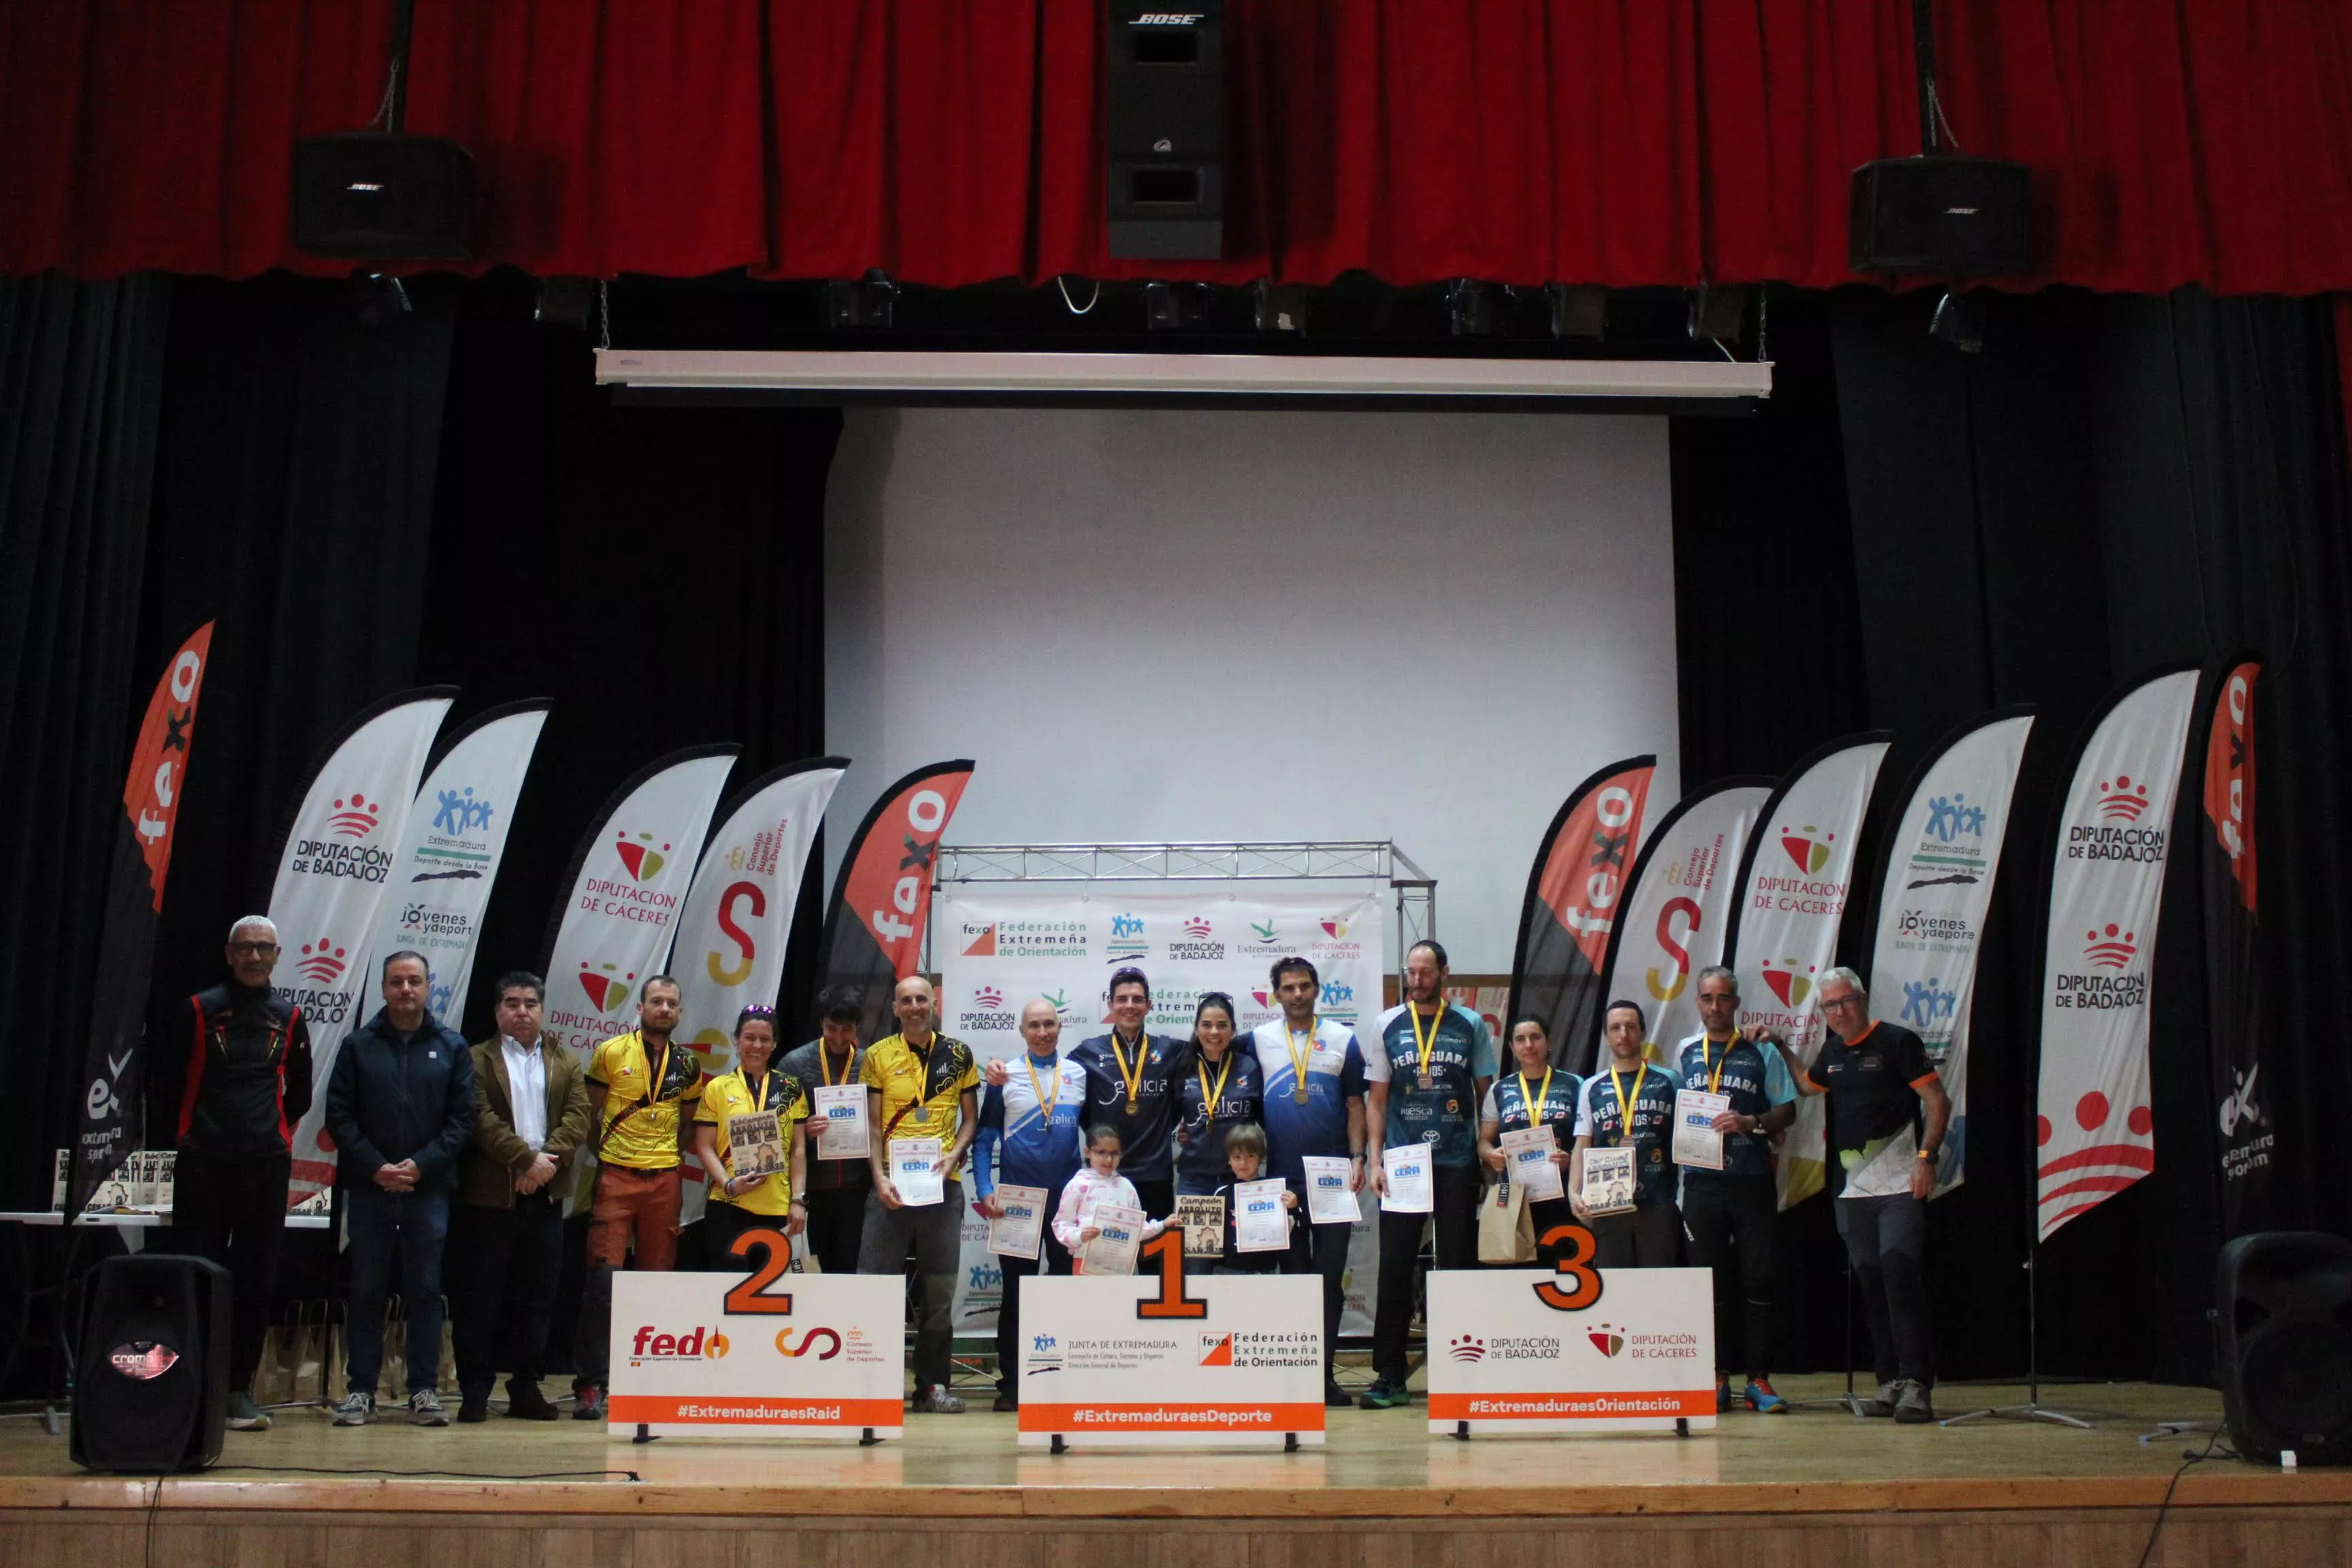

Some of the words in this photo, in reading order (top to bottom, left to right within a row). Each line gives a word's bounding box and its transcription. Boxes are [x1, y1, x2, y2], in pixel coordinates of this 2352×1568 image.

[1128, 14, 1204, 24] BOSE
[138, 650, 201, 845] fexo
[428, 836, 487, 851] Extremadura
[770, 818, 787, 859] Deportes
[2070, 826, 2164, 847] DIPUTACIÓN
[297, 840, 393, 868] DIPUTACIÓN
[747, 832, 763, 872] Consejo
[756, 832, 774, 874] Superior
[1921, 843, 1980, 856] Extremadura
[2069, 846, 2084, 859] DE
[2087, 845, 2163, 864] BADAJOZ
[414, 855, 441, 866] Deporte
[443, 858, 463, 868] desde
[474, 862, 488, 870] Base
[767, 859, 774, 876] de
[872, 789, 946, 943] fexo
[1567, 786, 1633, 938] fexo
[1684, 847, 1700, 886] Consejo
[1908, 863, 1935, 873] Deporte
[1937, 865, 1957, 874] desde
[292, 859, 308, 873] DE
[312, 858, 389, 883] BADAJOZ
[1758, 876, 1846, 897] DIPUTACIÓN
[581, 896, 599, 911] DE
[604, 898, 670, 927] CÁCERES
[1754, 895, 1774, 909] DE
[1779, 895, 1843, 915] CÁCERES
[423, 924, 472, 935] ydeport
[964, 923, 990, 934] fexo
[1000, 921, 1086, 932] Federación
[1000, 933, 1086, 944] Extremeña
[1170, 941, 1224, 951] DIPUTACIÓN
[999, 947, 1014, 957] de
[1017, 946, 1086, 957] Orientación
[1181, 951, 1224, 960] BADAJOZ
[1237, 945, 1296, 953] Extremadura
[2055, 994, 2072, 1008] DE
[2077, 989, 2144, 1009] BADAOZ
[961, 1011, 1015, 1022] DIPUTACIÓN
[1156, 1014, 1196, 1024] Orient
[972, 1022, 1015, 1030] BADAJOZ
[1098, 1078, 1168, 1105] glicia
[828, 1108, 856, 1119] CERA
[902, 1161, 930, 1172] CERA
[1180, 1196, 1222, 1206] Campeón
[1248, 1202, 1275, 1212] CERA
[1178, 1206, 1222, 1214] ABSOLUTO
[724, 1226, 793, 1316] 2
[1137, 1226, 1208, 1319] 1
[1533, 1223, 1603, 1312] 3
[1068, 1341, 1097, 1350] JUNTA
[1100, 1341, 1110, 1349] DE
[1113, 1341, 1177, 1349] EXTREMADURA
[1203, 1335, 1229, 1347] fexo
[1235, 1331, 1318, 1343] Federación
[1491, 1335, 1560, 1348] DIPUTACIÓN
[1632, 1332, 1697, 1345] DIPUTACIÓN
[1235, 1343, 1318, 1355] Extremeña
[1491, 1351, 1502, 1359] DE
[1505, 1349, 1560, 1359] BADAJOZ
[1632, 1349, 1645, 1358] DE
[1649, 1345, 1697, 1358] CÁCERES
[1234, 1357, 1247, 1367] de
[1252, 1356, 1318, 1367] Orientación
[677, 1405, 840, 1420] #ExtremaduraesRaid
[1469, 1397, 1680, 1413] #ExtremaduraesOrientación
[1073, 1408, 1273, 1426] #ExtremaduraesDeporte
